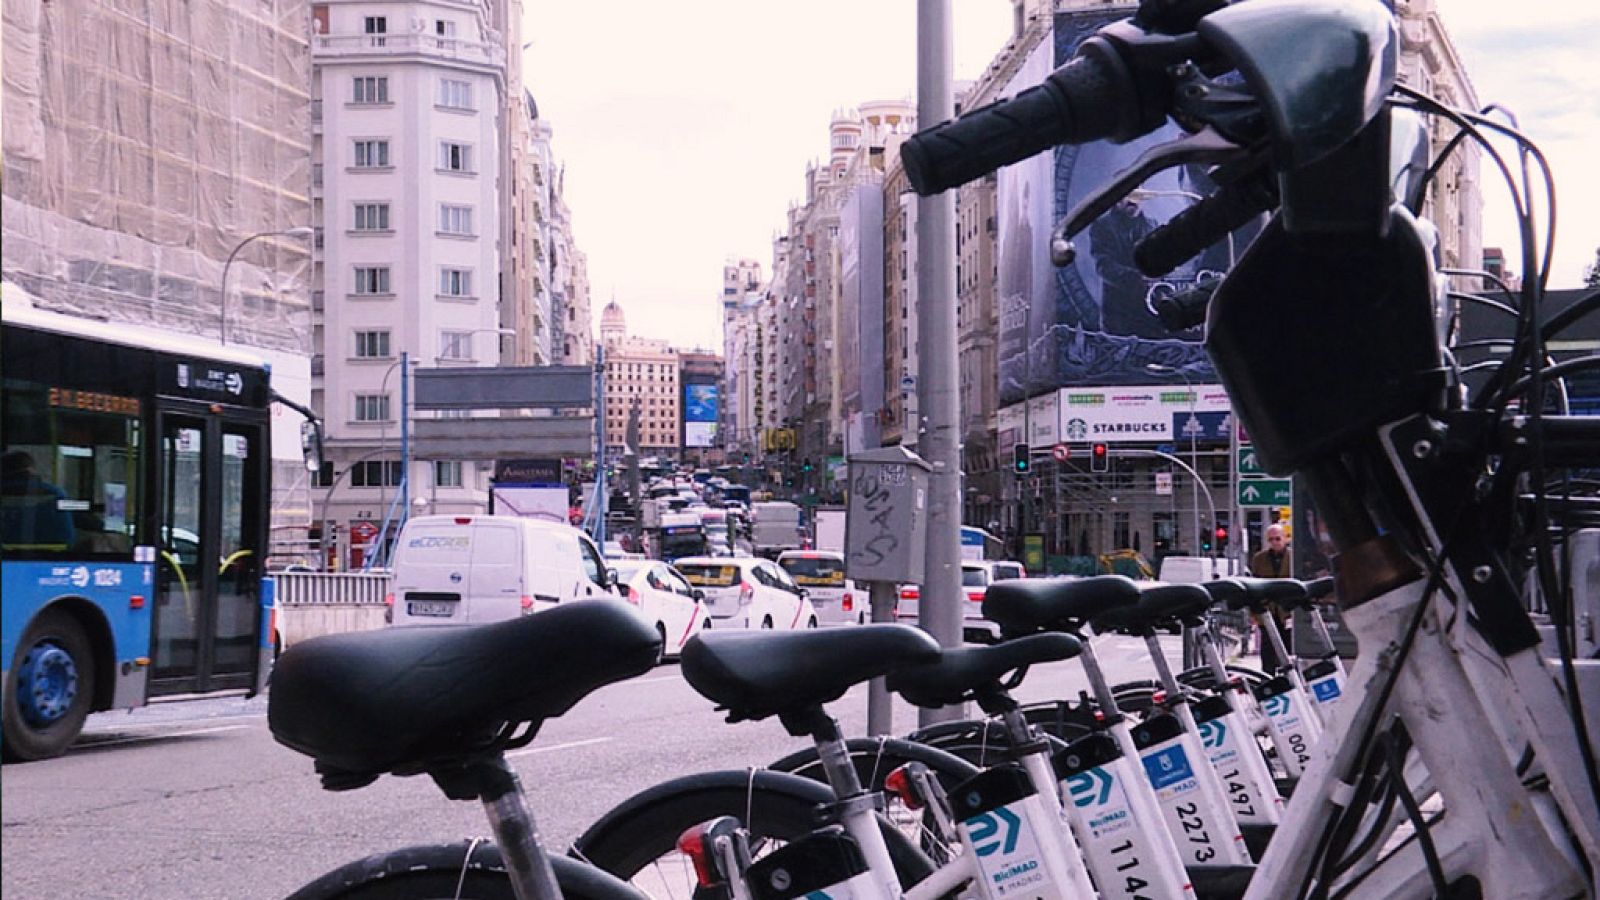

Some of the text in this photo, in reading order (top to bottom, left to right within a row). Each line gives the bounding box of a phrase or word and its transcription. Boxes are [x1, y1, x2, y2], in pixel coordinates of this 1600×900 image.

[1093, 422, 1167, 434] STARBUCKS
[93, 568, 122, 586] 1024
[1288, 733, 1311, 773] 004
[1223, 768, 1256, 817] 1497
[1175, 802, 1216, 863] 2273
[993, 860, 1038, 884] BiciMAD
